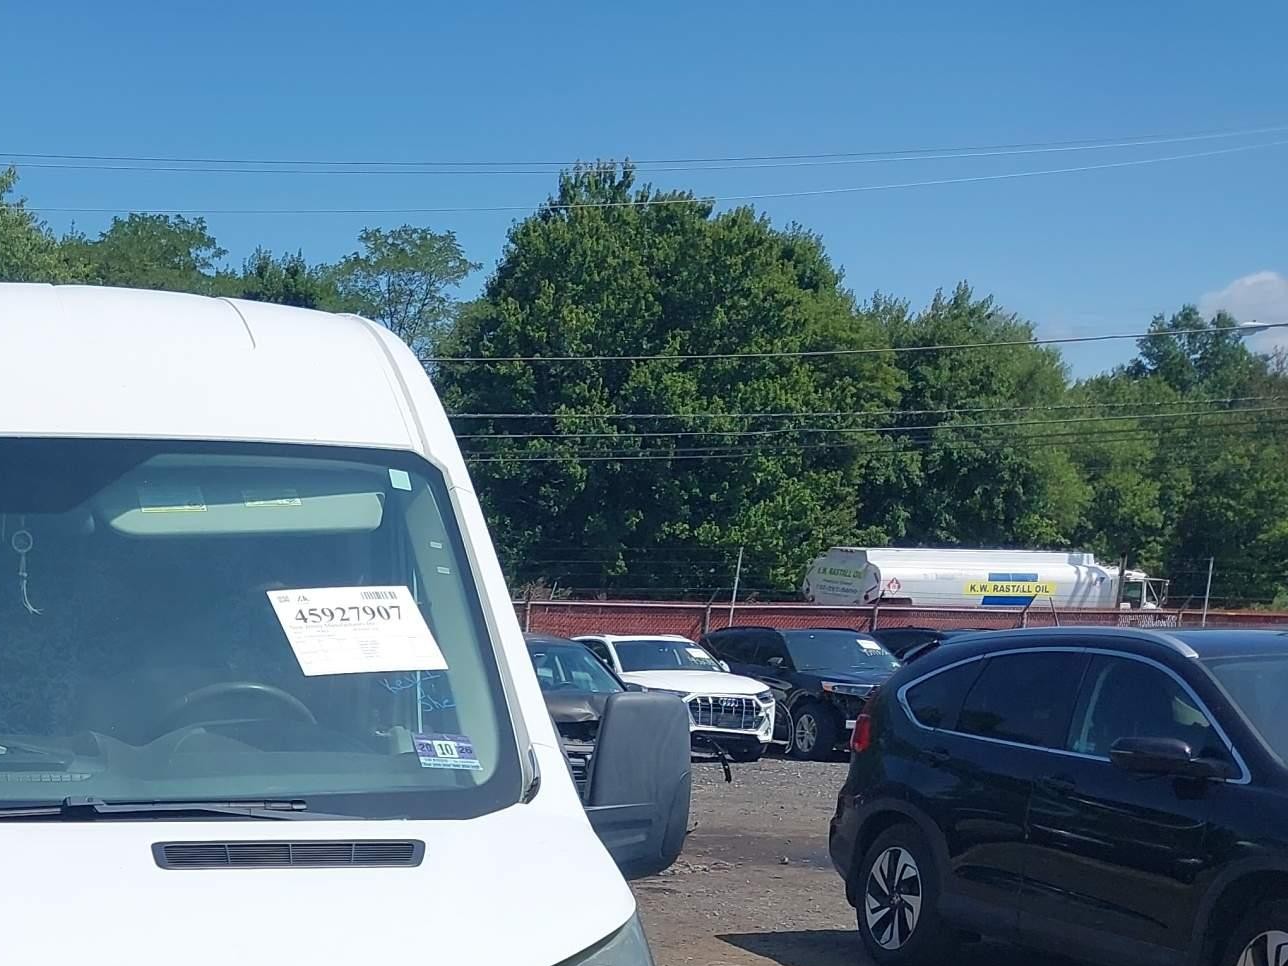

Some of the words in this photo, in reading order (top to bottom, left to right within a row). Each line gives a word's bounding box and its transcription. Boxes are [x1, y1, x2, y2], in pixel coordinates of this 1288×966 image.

[970, 584, 990, 593] K.W.
[993, 584, 1032, 593] RASTALL
[1035, 585, 1050, 593] OIL
[295, 605, 402, 623] 45927907
[418, 742, 433, 753] 20
[438, 743, 454, 755] 10
